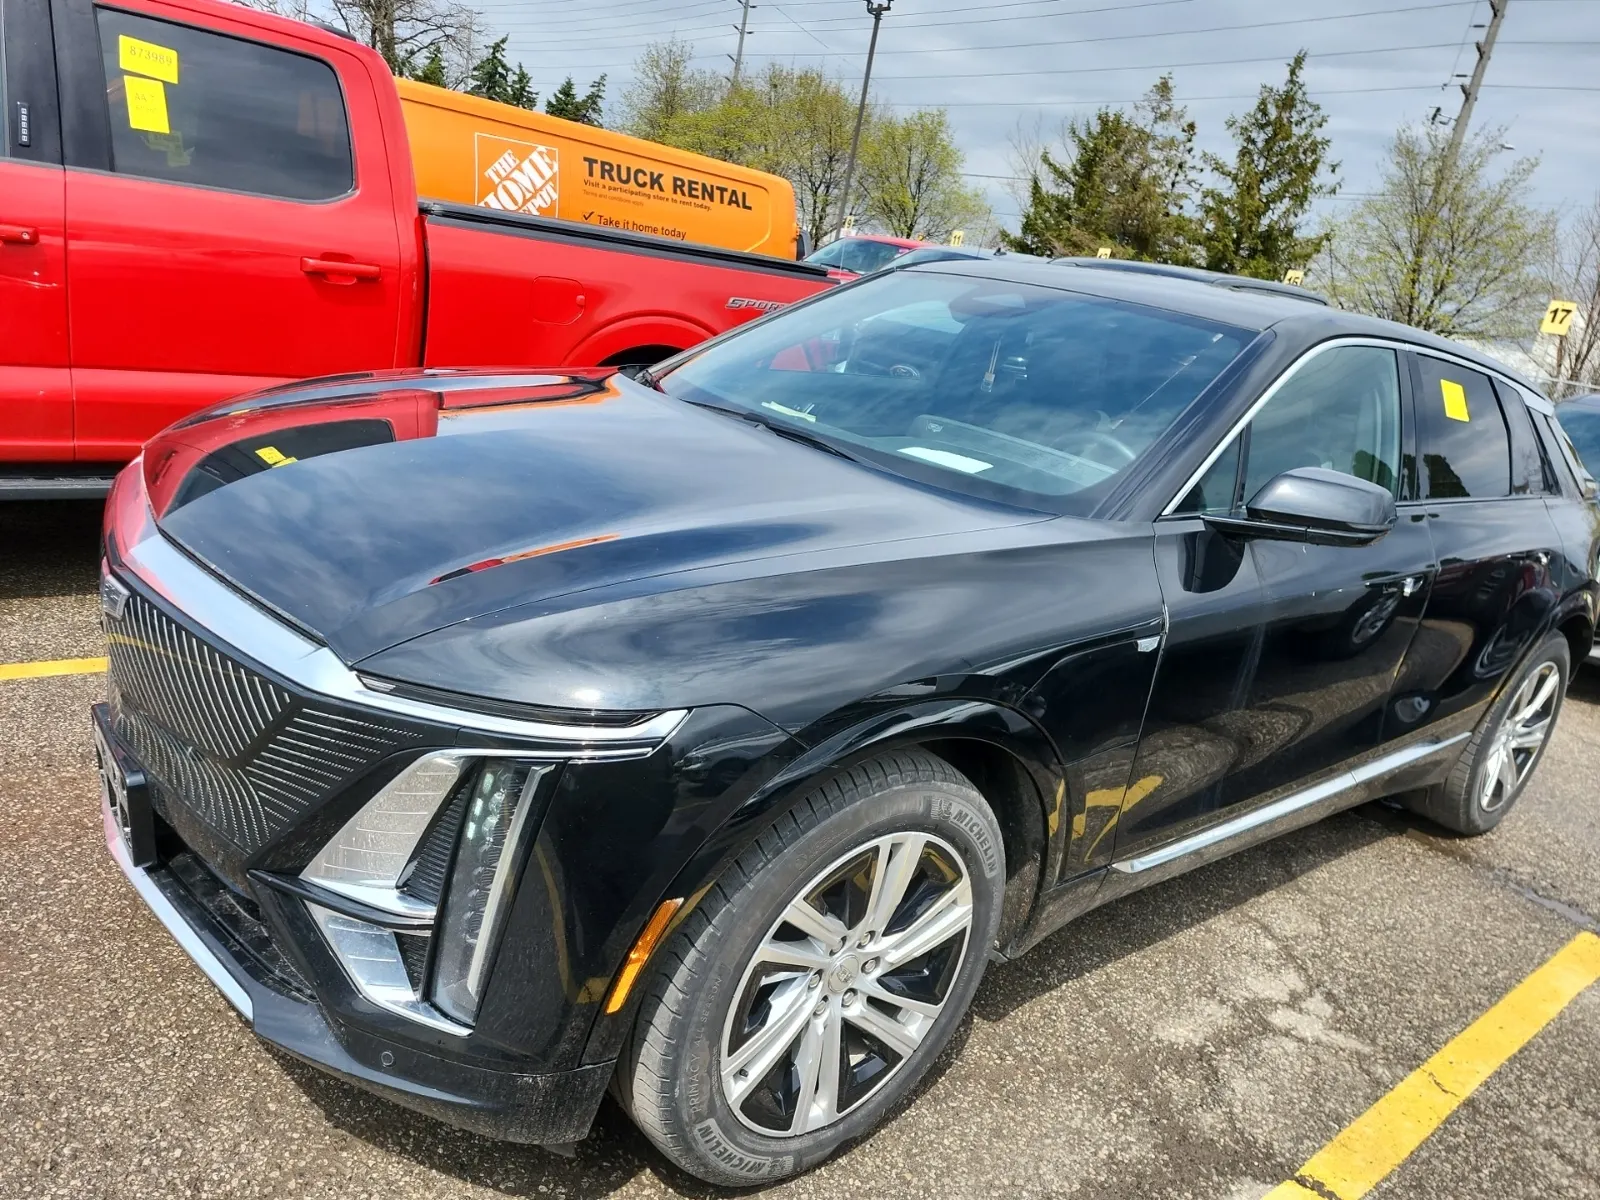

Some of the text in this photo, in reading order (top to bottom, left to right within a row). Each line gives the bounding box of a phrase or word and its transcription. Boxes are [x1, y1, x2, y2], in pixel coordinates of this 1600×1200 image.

[484, 149, 520, 185] THE
[583, 156, 753, 211] TRUCK RENTAL
[518, 181, 558, 215] POT
[583, 179, 600, 189] Visit
[607, 185, 651, 200] participating
[652, 193, 670, 202] store
[597, 214, 687, 241] Take it home today
[953, 234, 962, 245] 11
[1550, 307, 1573, 325] 17
[952, 809, 998, 874] MICHELIN
[689, 978, 723, 1114] PRIMACY ALL SEASON
[697, 1124, 767, 1174] MICHELIN
